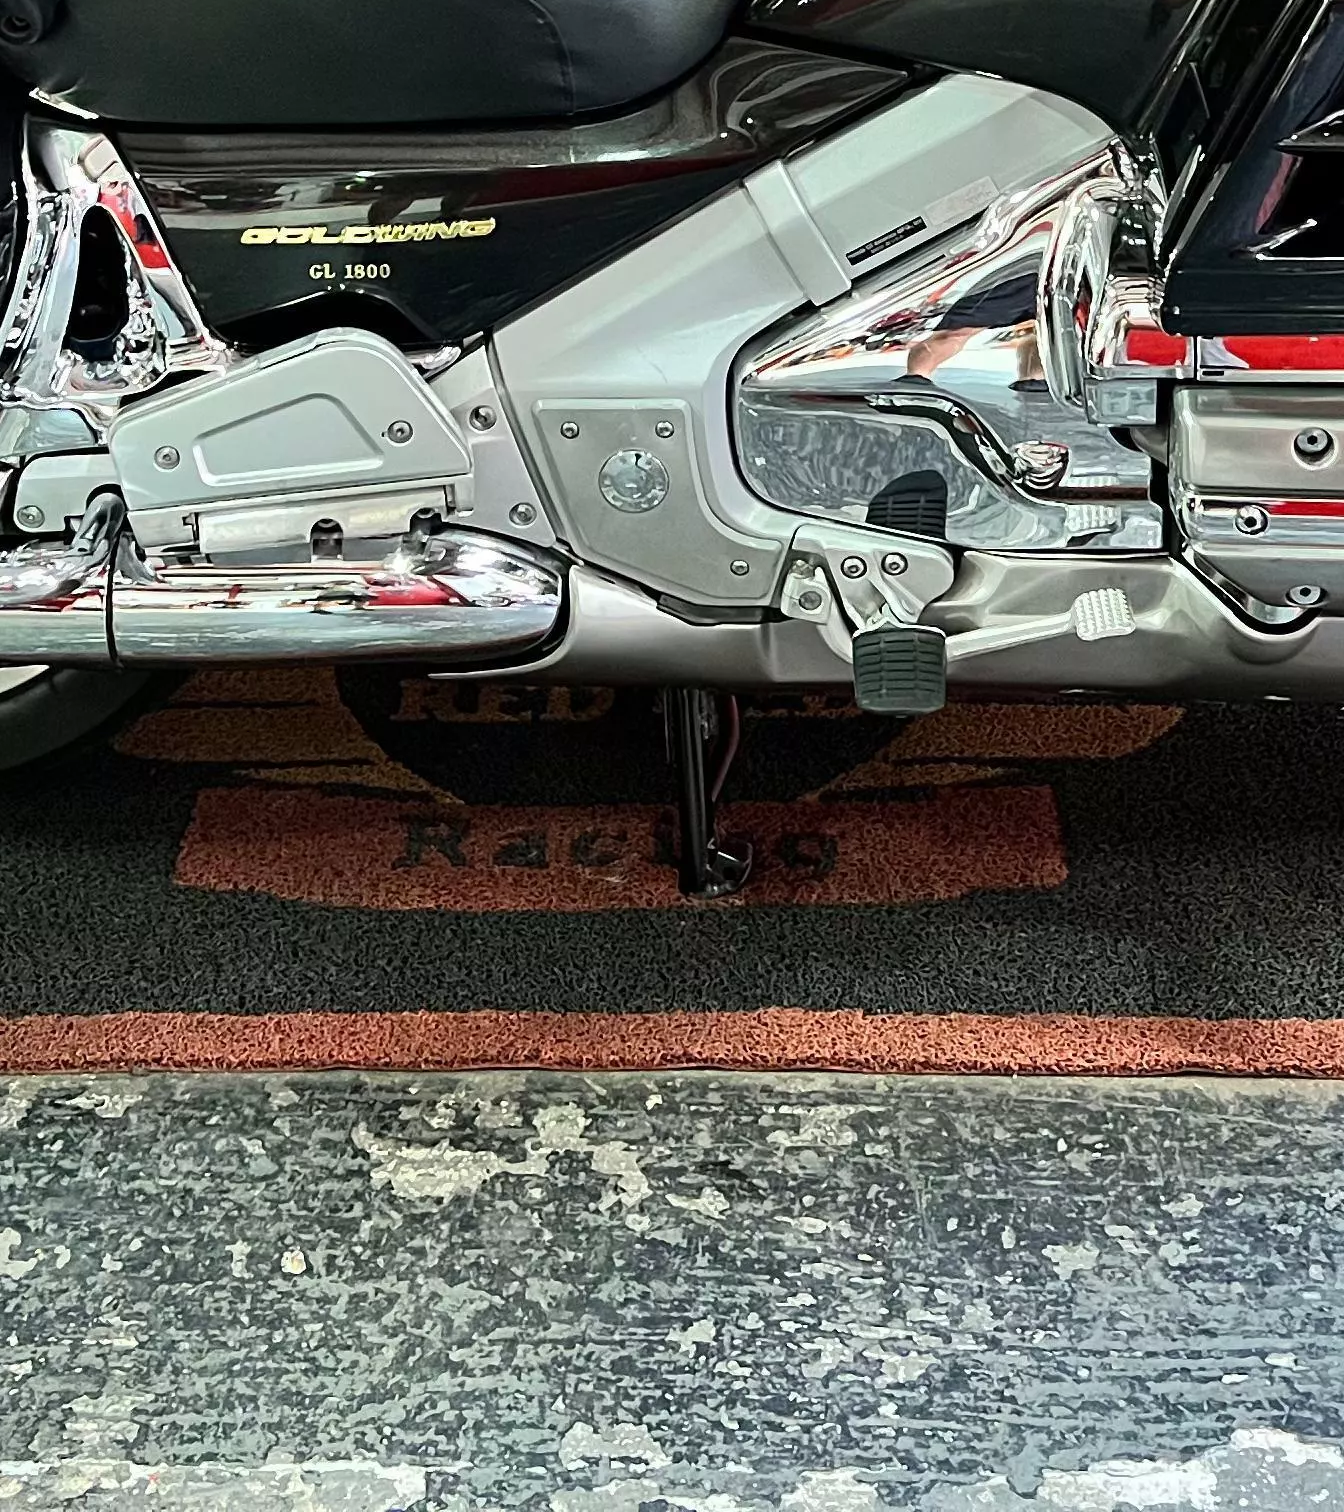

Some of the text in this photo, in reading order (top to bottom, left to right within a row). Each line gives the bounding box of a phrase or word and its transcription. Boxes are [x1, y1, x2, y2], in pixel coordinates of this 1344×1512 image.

[309, 263, 391, 279] GL 1800
[389, 680, 616, 723] RED
